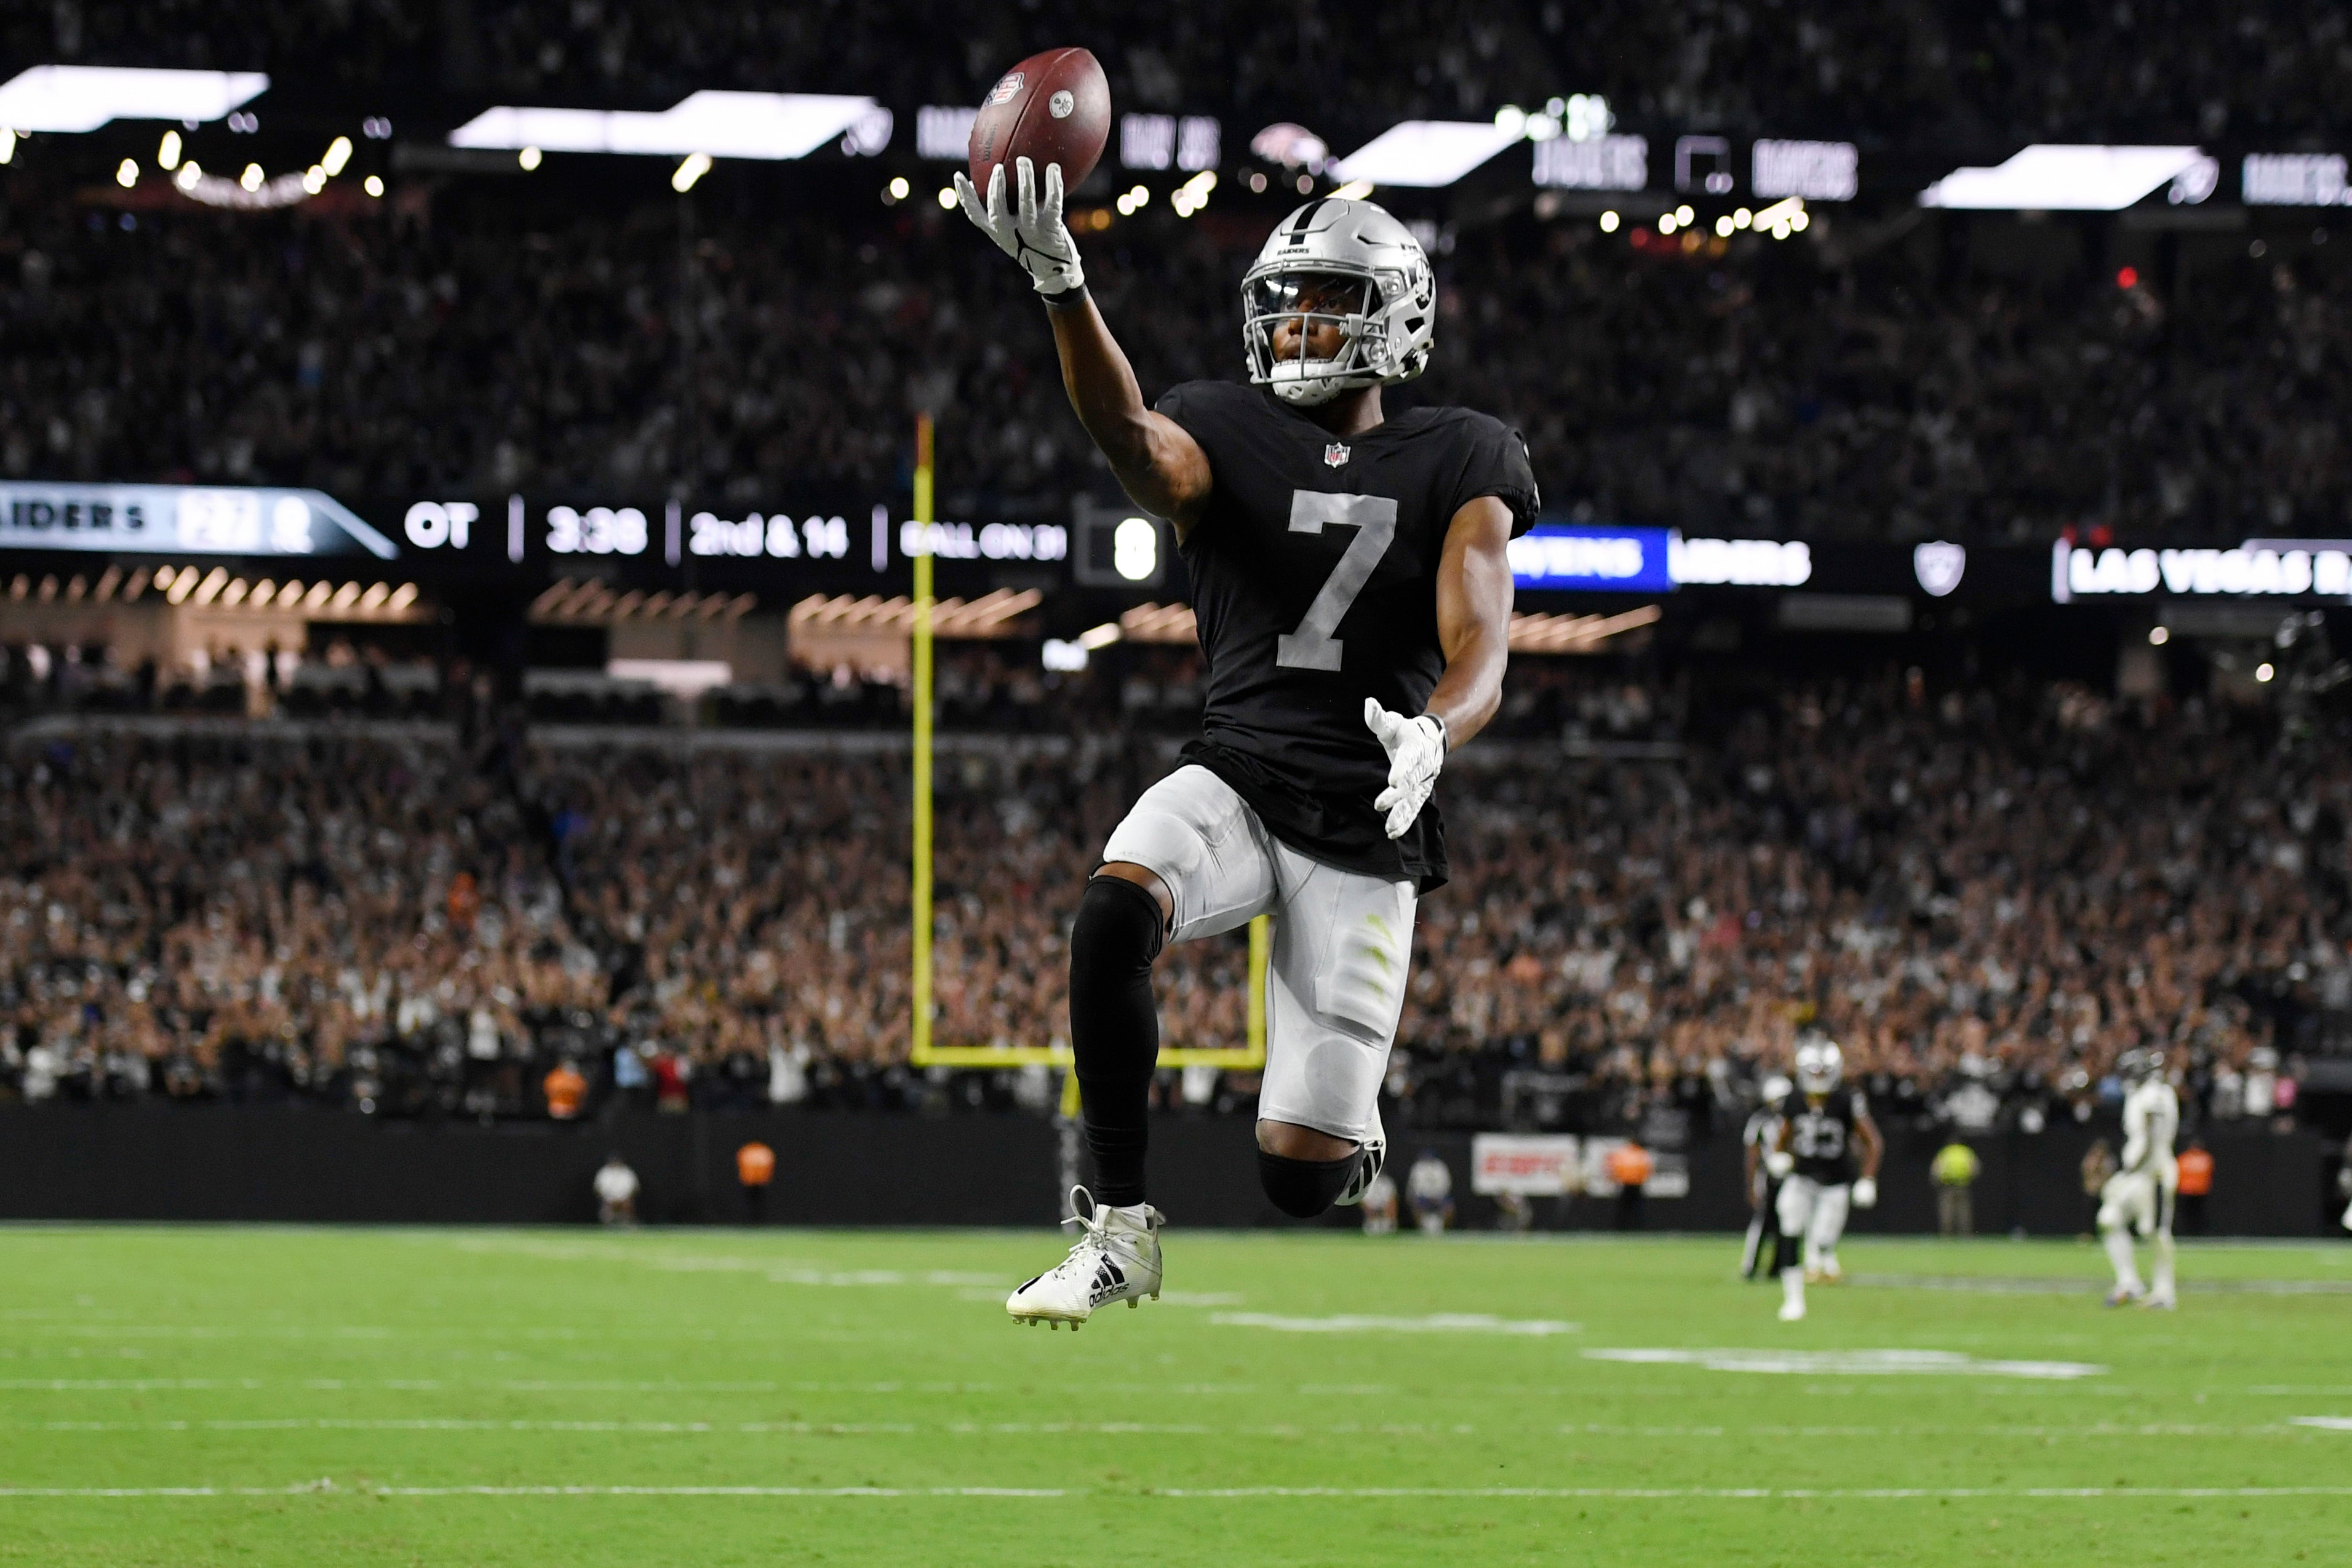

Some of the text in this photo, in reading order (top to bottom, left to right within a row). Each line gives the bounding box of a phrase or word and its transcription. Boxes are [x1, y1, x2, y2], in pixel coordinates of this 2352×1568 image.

[995, 75, 1019, 100] NFL
[1277, 247, 1310, 256] RAIDERS
[0, 501, 144, 531] IDERS
[404, 501, 479, 549] OT
[690, 511, 763, 556] 2nd
[1276, 489, 1397, 671] 7
[2069, 548, 2352, 595] LAS VEGAS R
[1089, 1283, 1130, 1308] adidas
